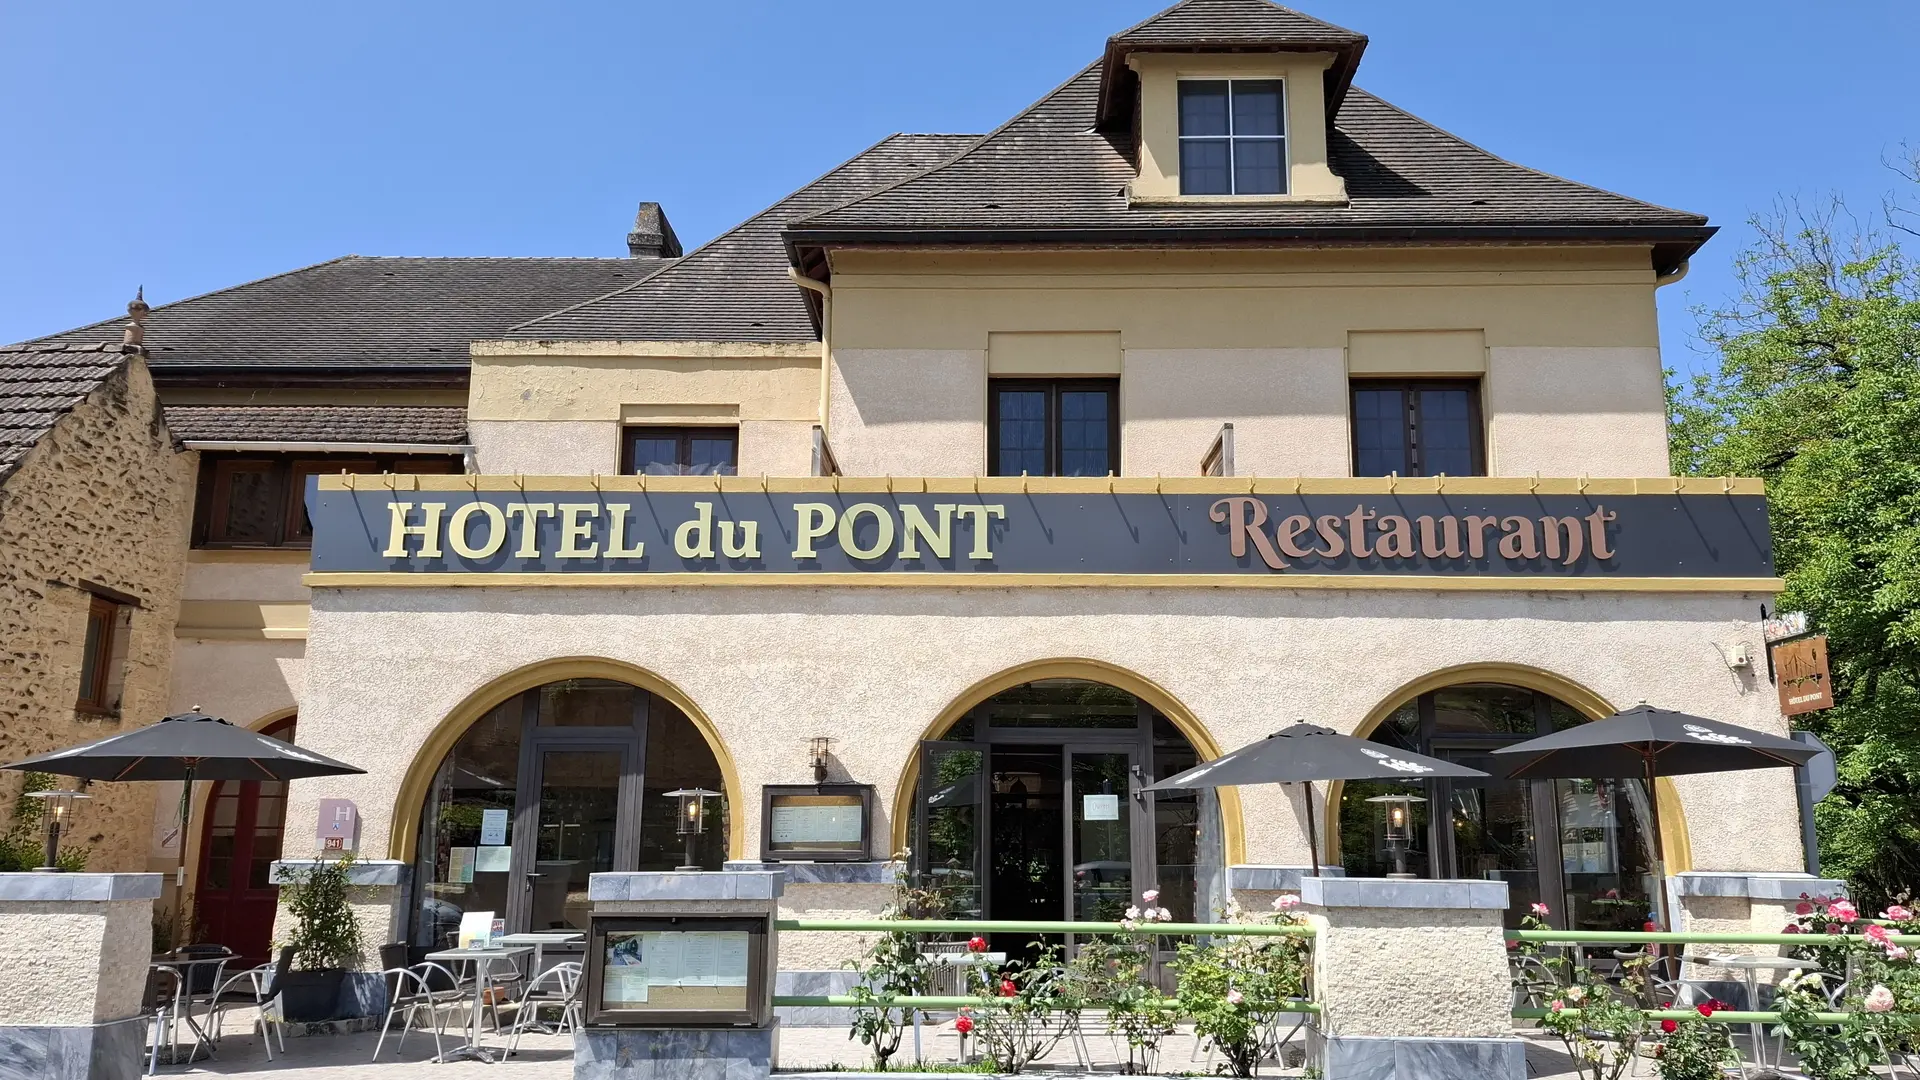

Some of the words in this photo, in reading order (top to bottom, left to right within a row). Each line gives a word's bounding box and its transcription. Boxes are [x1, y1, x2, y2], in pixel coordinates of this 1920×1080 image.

[382, 501, 645, 558] HOTEL
[674, 501, 761, 559] du
[791, 502, 1005, 560] PONT
[1209, 496, 1617, 570] Restaurant
[335, 806, 350, 821] H
[327, 839, 341, 849] 941
